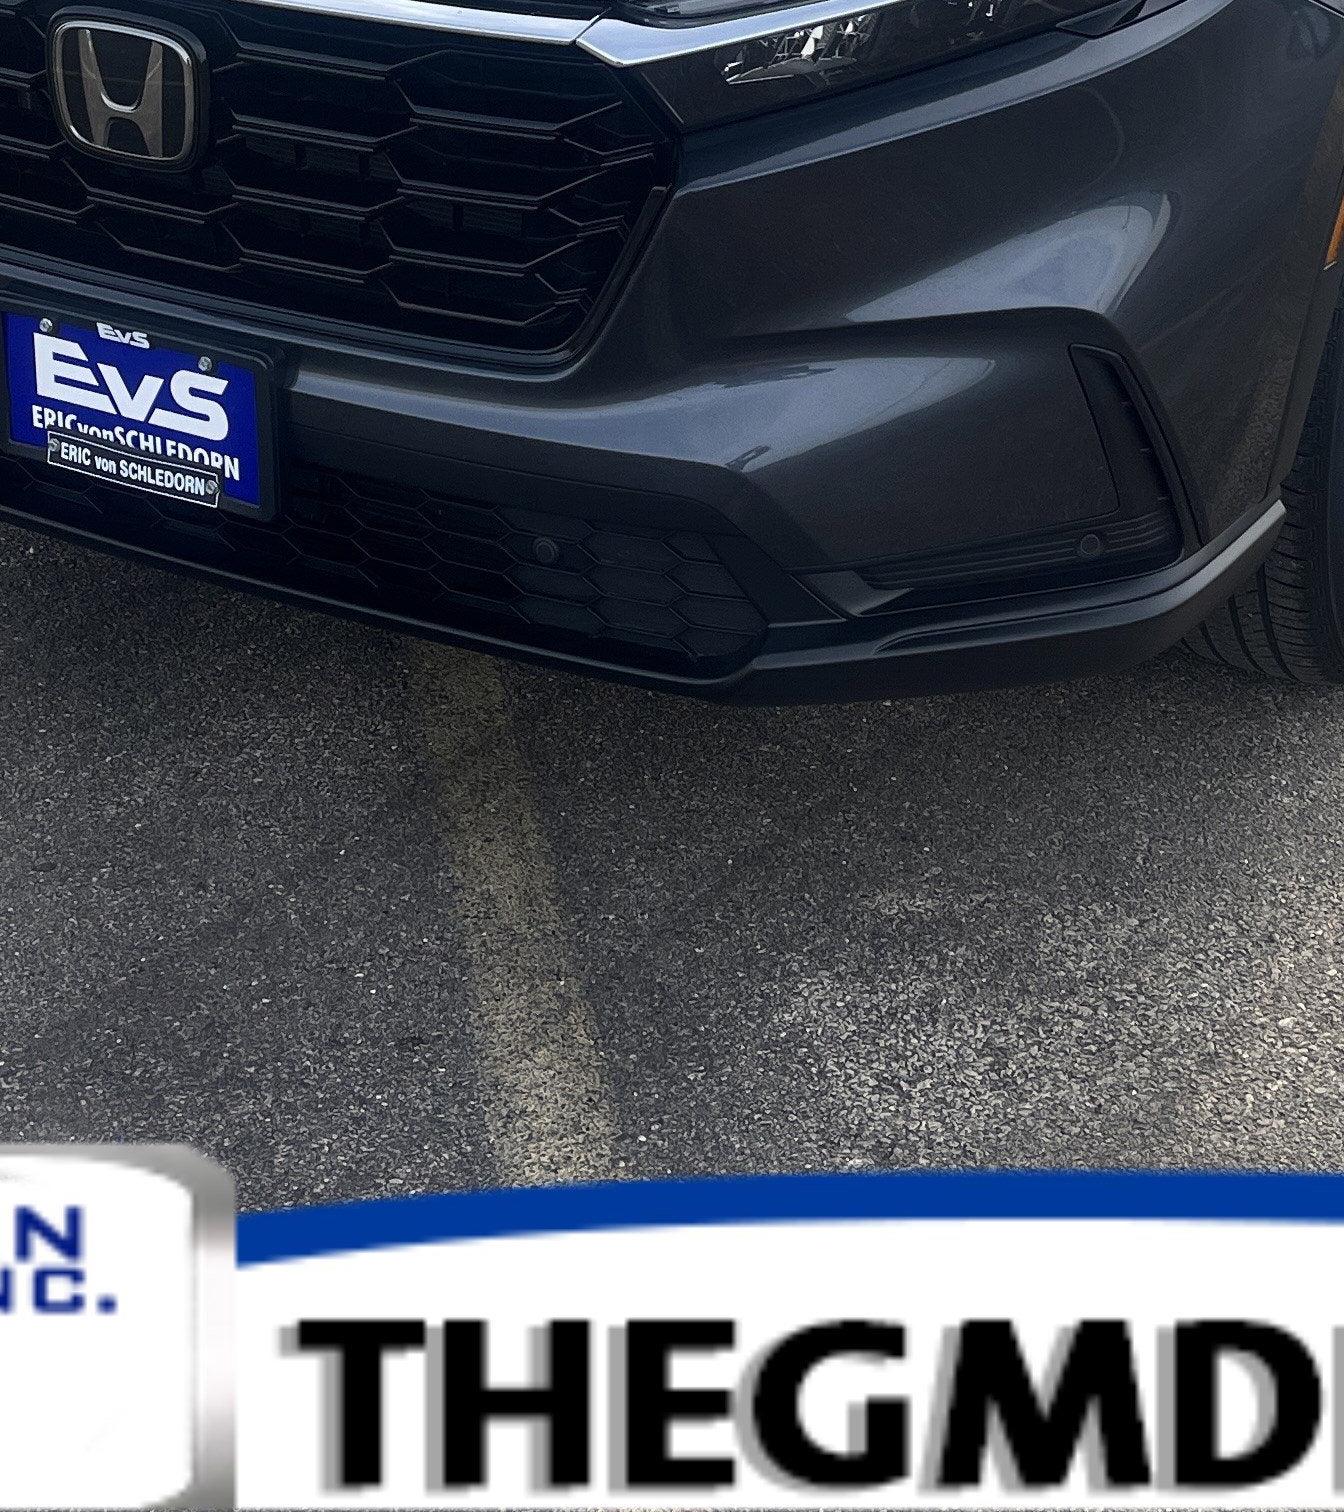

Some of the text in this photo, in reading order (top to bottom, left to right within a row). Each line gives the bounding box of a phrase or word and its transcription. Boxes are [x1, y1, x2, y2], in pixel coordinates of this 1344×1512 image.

[60, 442, 205, 496] ERIC von SCHLEDORN
